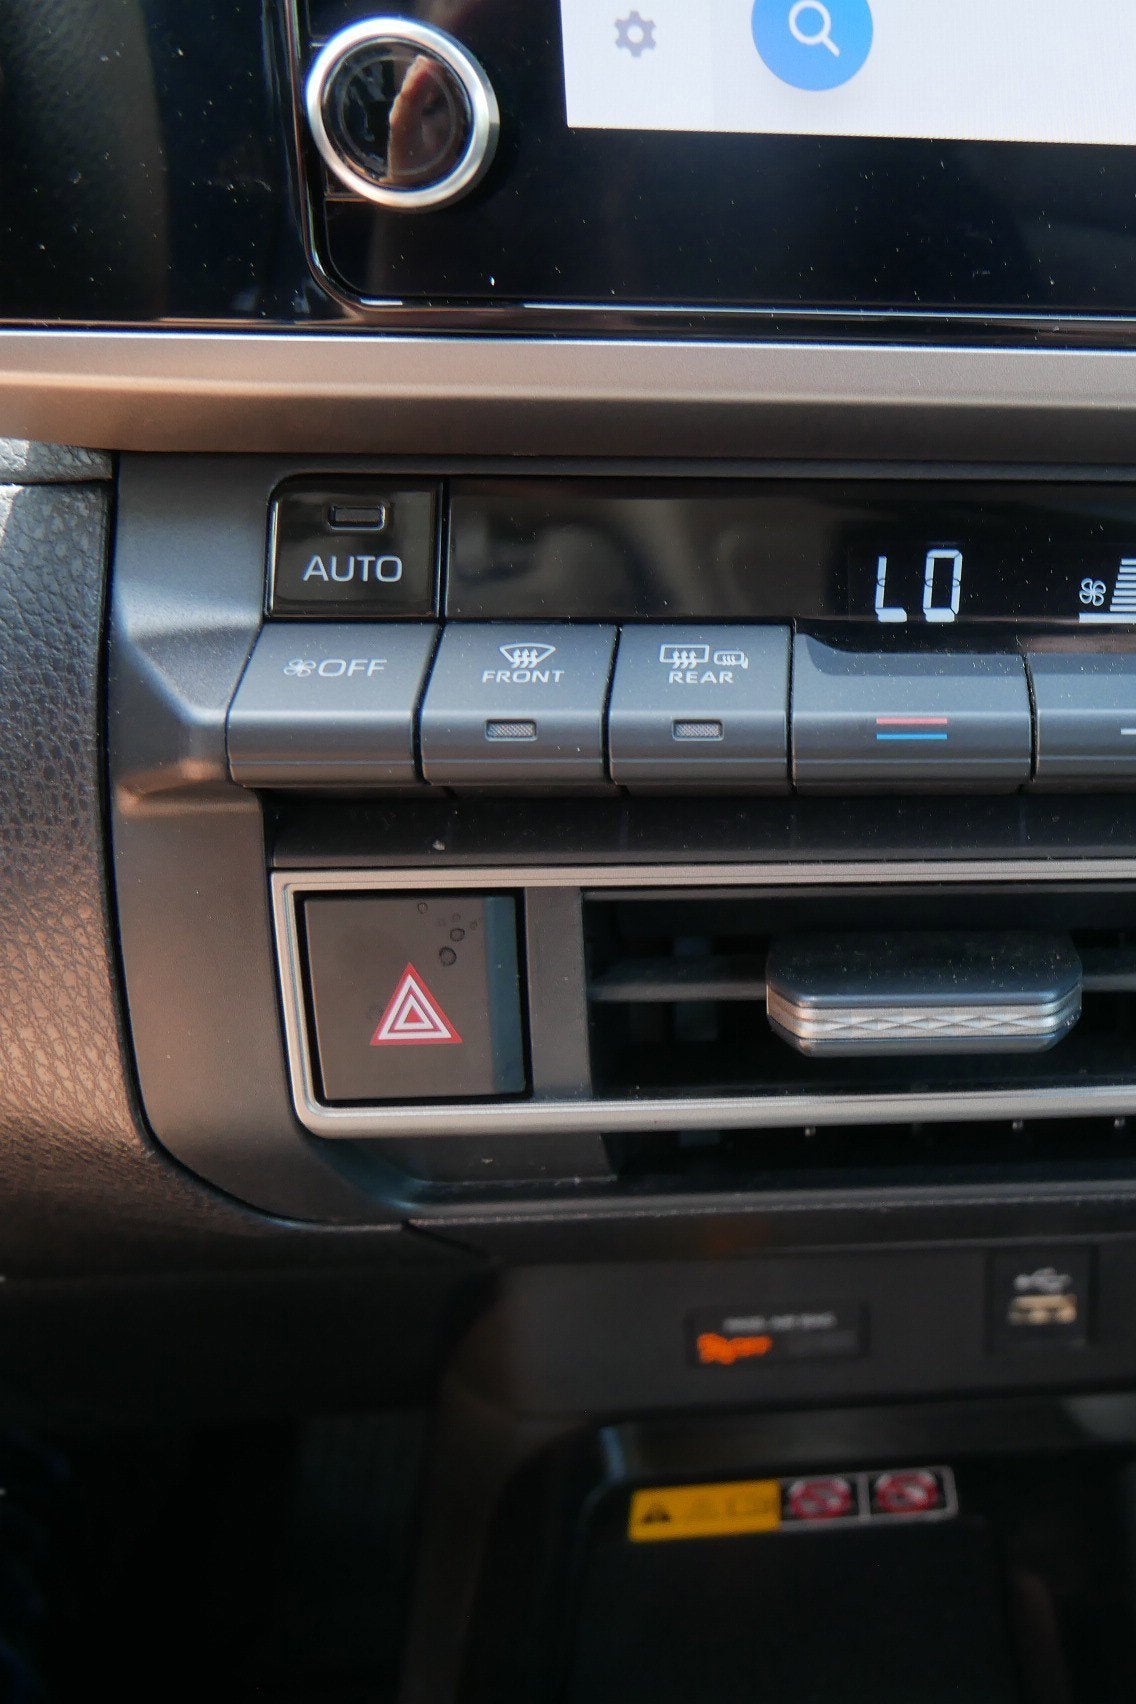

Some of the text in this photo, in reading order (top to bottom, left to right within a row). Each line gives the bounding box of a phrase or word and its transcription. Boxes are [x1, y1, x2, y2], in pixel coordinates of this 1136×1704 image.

[302, 554, 403, 583] AUTO
[318, 658, 388, 678] OFF
[481, 670, 565, 684] FRONT
[668, 671, 734, 684] REAR
